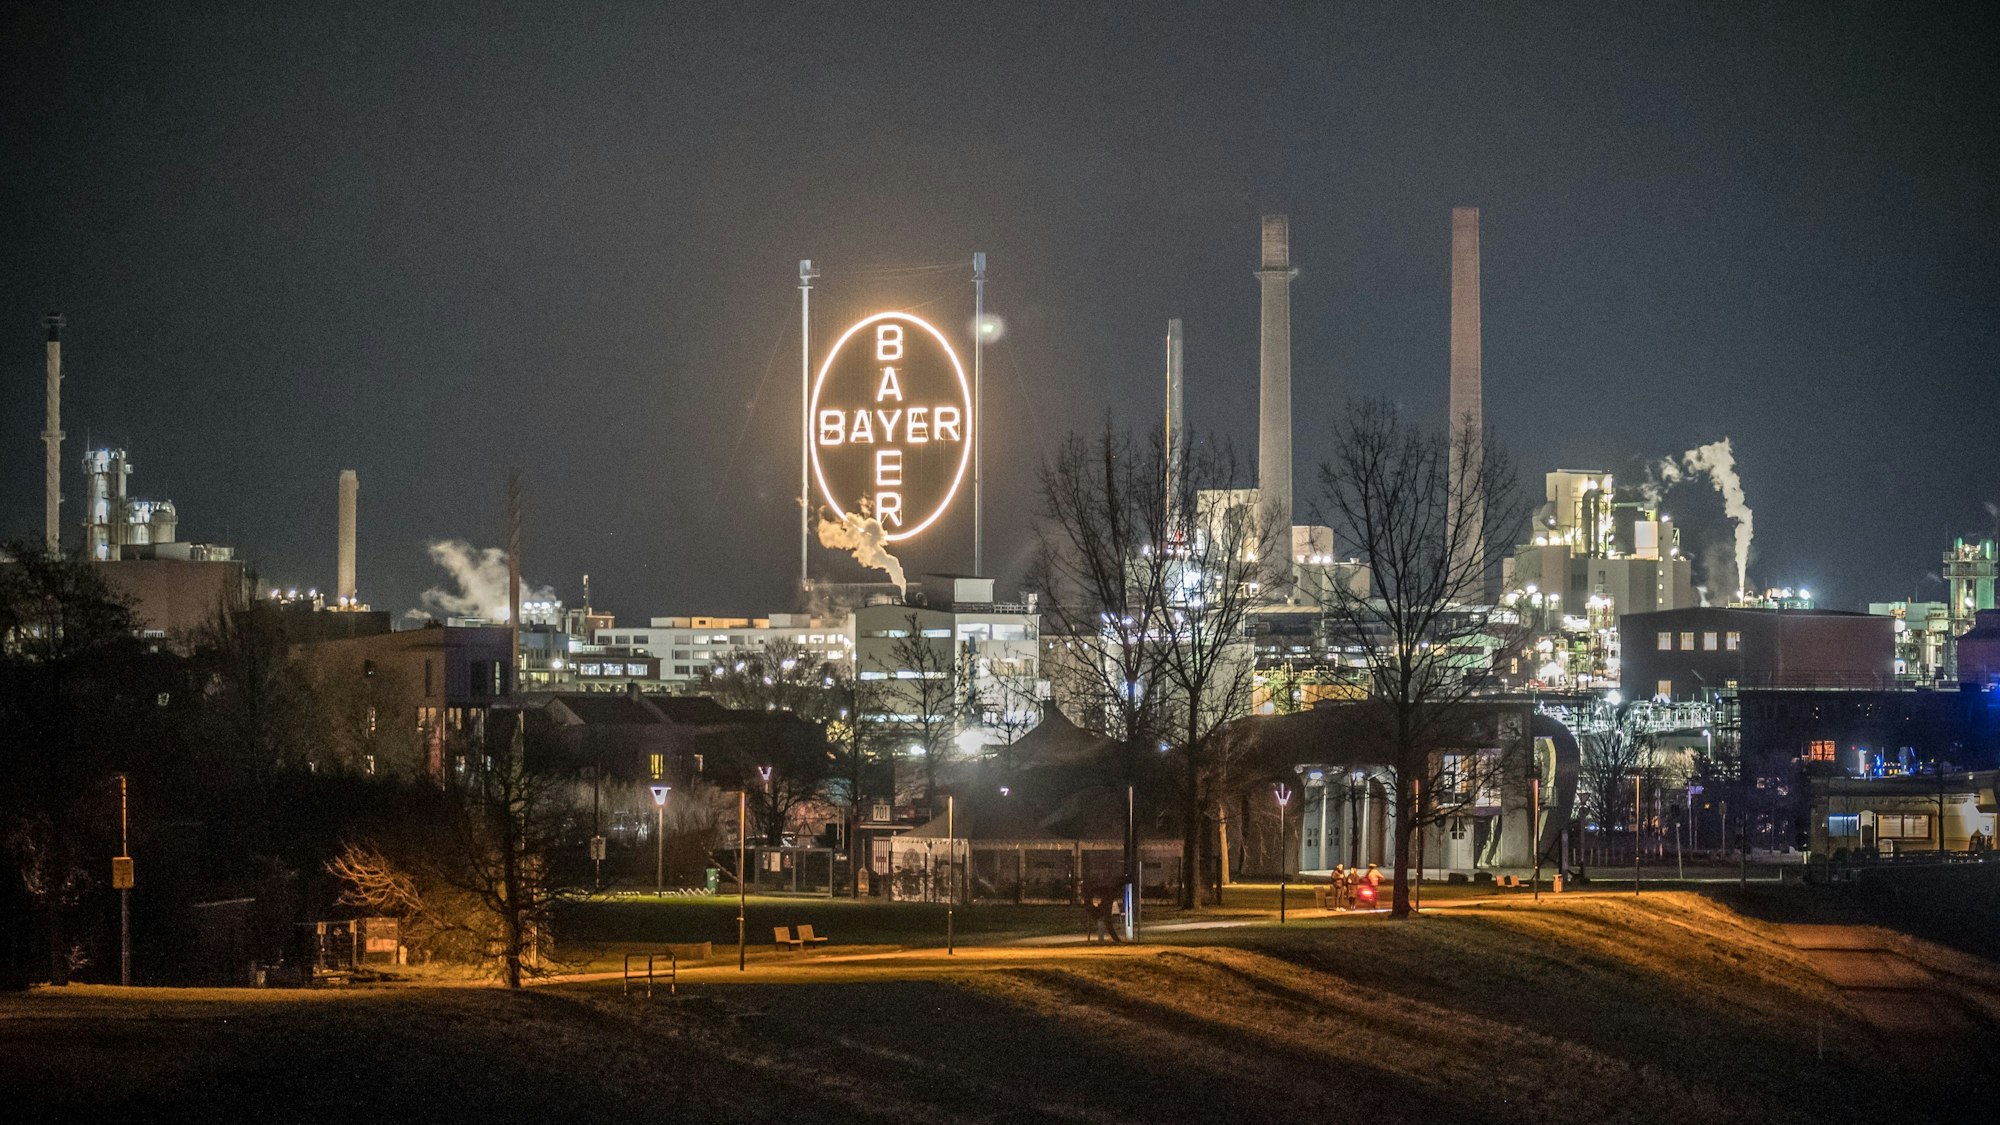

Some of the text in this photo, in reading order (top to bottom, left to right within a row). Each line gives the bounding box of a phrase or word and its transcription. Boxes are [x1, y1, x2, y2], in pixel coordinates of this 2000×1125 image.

[820, 407, 960, 445] BAYER
[876, 324, 903, 526] BAYER
[875, 806, 888, 819] 701
